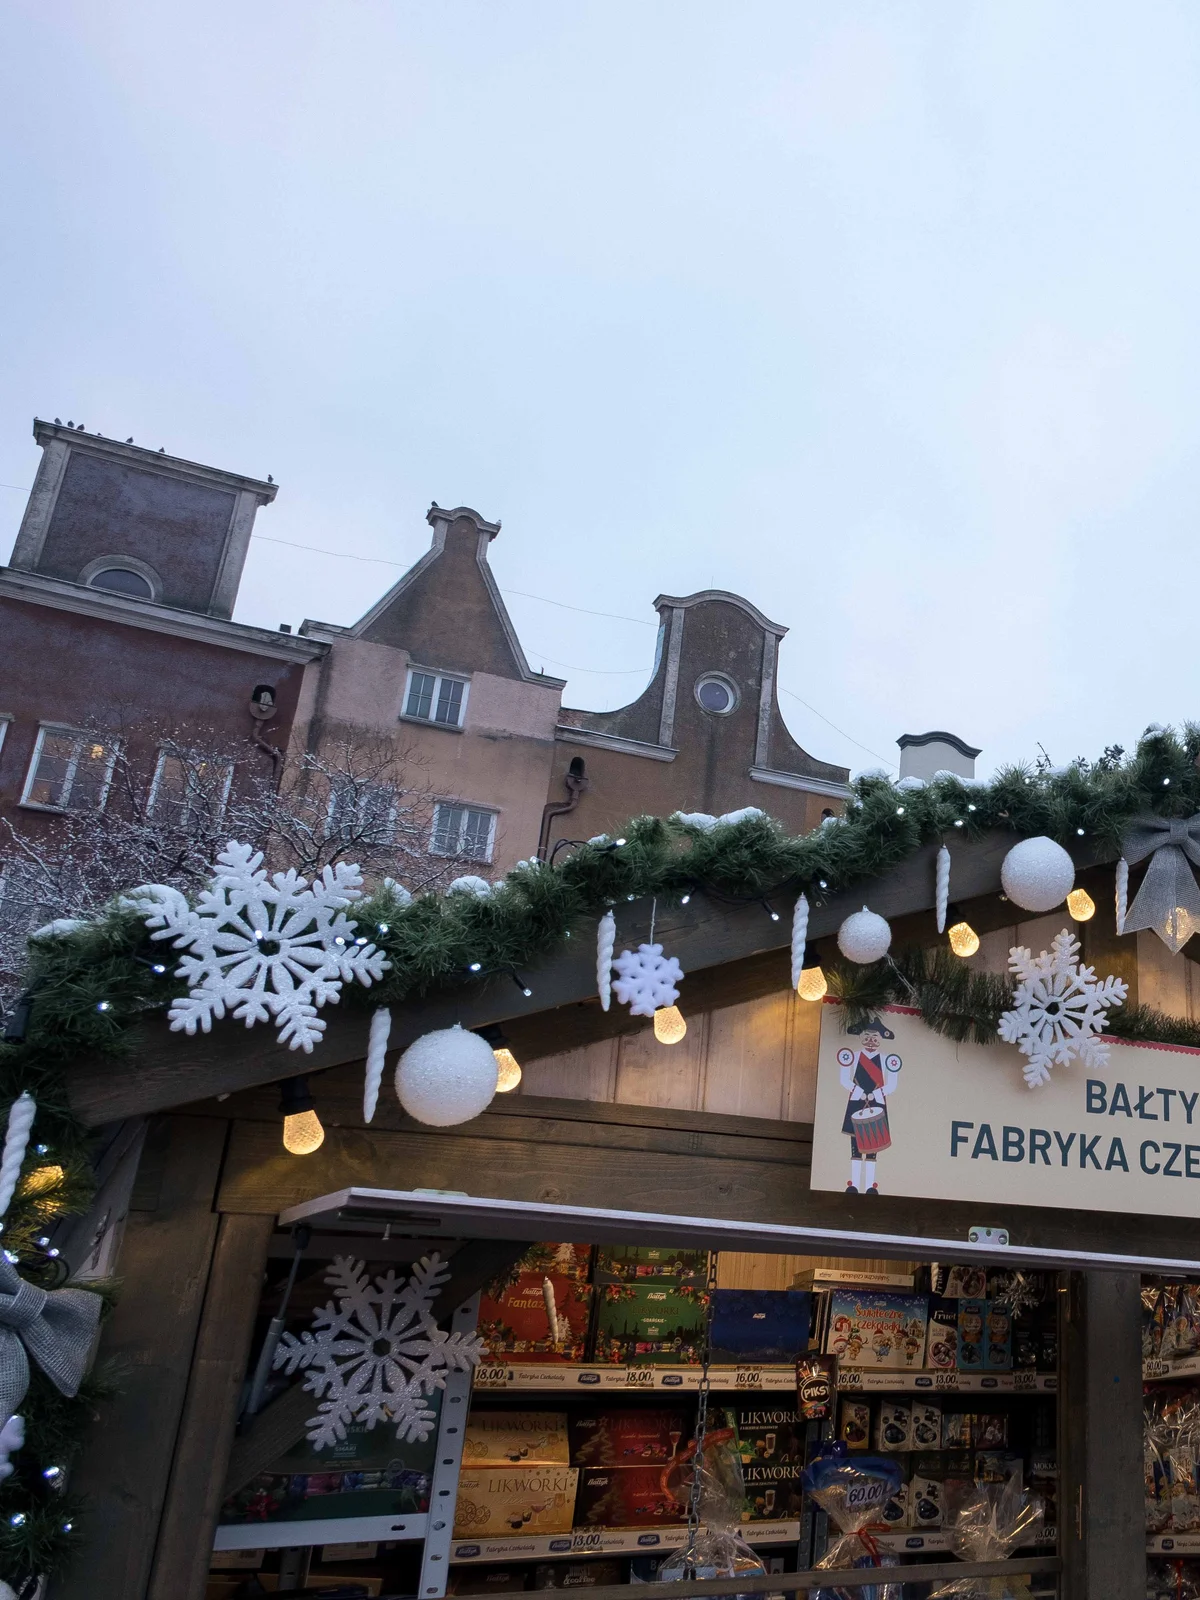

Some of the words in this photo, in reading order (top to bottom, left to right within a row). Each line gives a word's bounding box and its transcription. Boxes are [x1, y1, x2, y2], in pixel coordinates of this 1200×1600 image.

[950, 1121, 1129, 1174] FABRYKA
[507, 1297, 546, 1310] Fantaz
[856, 1319, 901, 1332] czekoladki
[475, 1368, 504, 1380] 18,00
[626, 1371, 651, 1383] 18,00
[736, 1373, 760, 1383] 16,00
[838, 1374, 860, 1384] 16,00
[935, 1374, 956, 1385] 13,00
[1014, 1374, 1034, 1384] 13,00
[740, 1410, 801, 1424] LIKWORK
[482, 1419, 560, 1432] LIKWORKI
[488, 1478, 569, 1493] LIKWORKI
[849, 1484, 882, 1505] 60,00
[572, 1534, 601, 1547] 13,00
